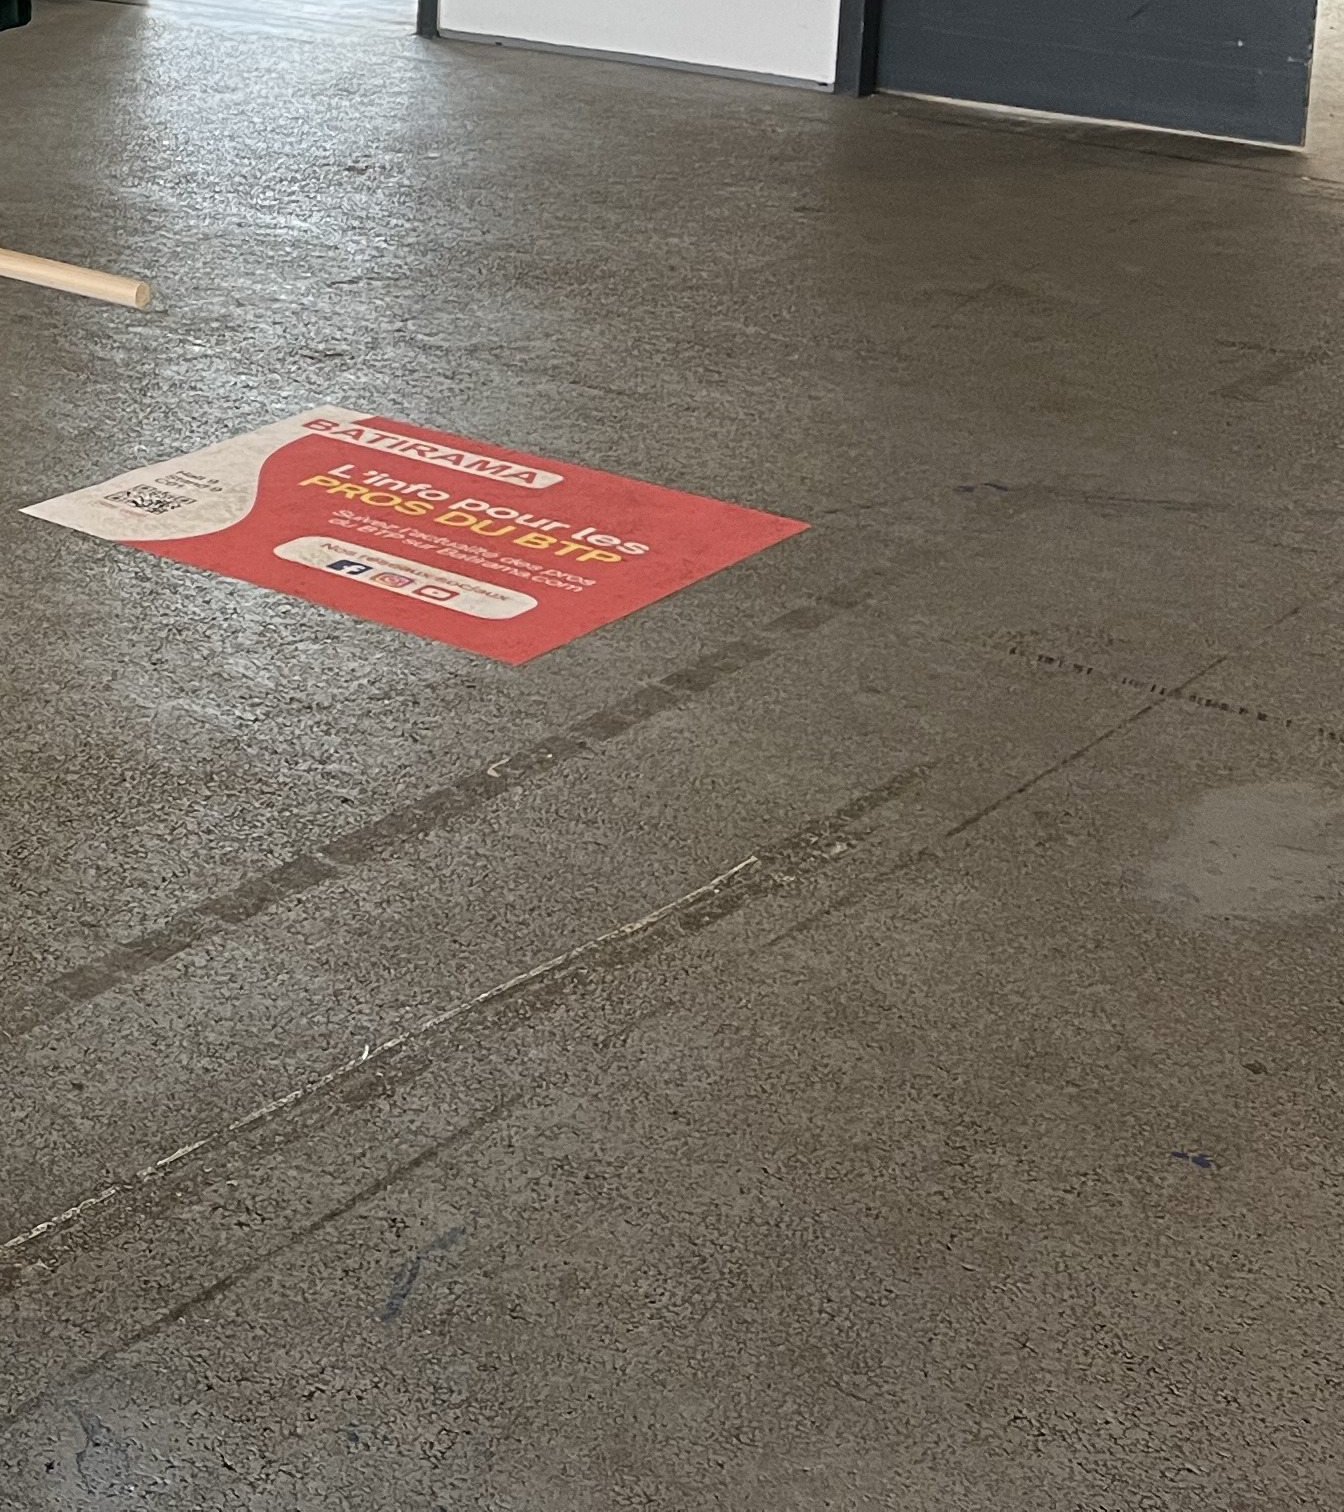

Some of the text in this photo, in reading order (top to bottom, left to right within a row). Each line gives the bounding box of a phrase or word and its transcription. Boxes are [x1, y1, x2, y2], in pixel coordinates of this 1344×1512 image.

[302, 418, 538, 485] BATIRAMA
[298, 474, 623, 563] PROS DU BTP
[327, 464, 650, 555] L'info pour les
